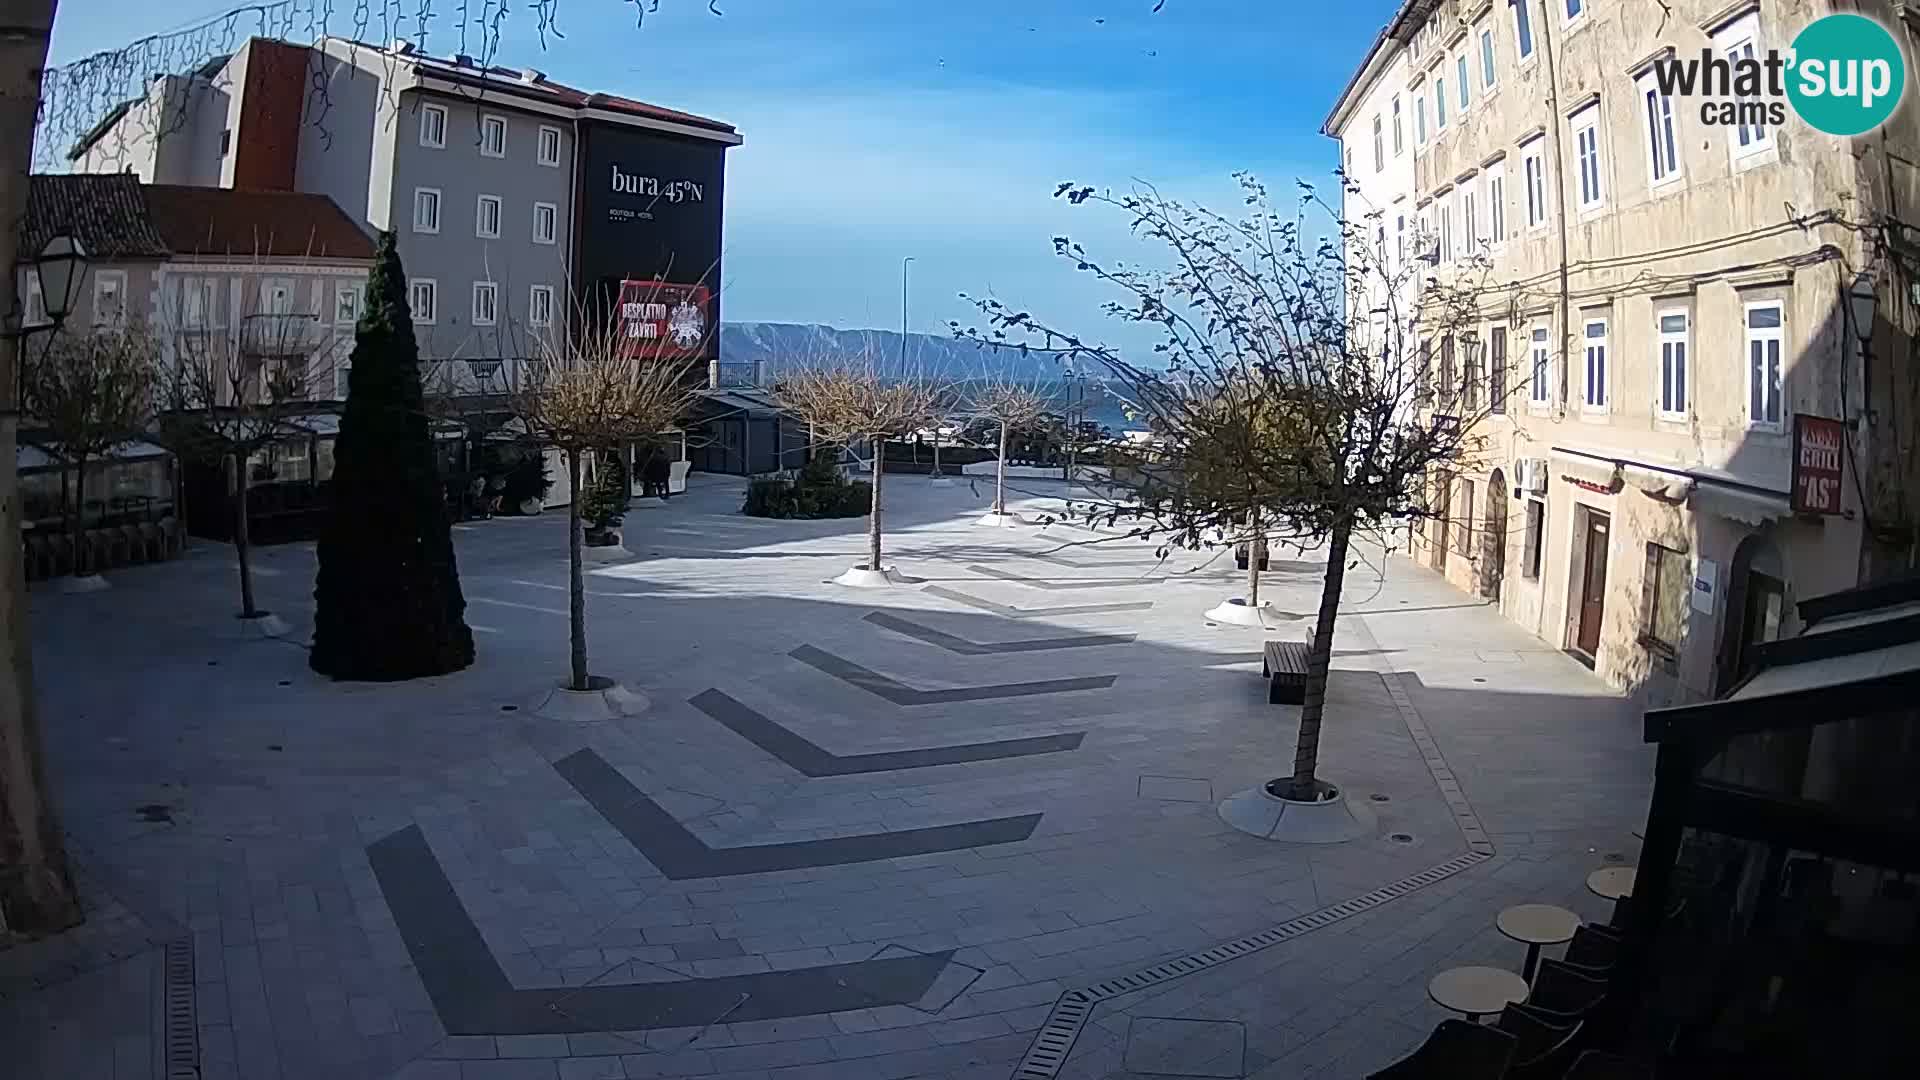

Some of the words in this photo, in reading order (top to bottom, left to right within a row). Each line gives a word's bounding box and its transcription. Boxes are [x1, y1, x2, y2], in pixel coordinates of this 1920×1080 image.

[612, 165, 658, 195] bura
[622, 303, 667, 320] BESPLATNO
[1800, 447, 1840, 471] GRILL
